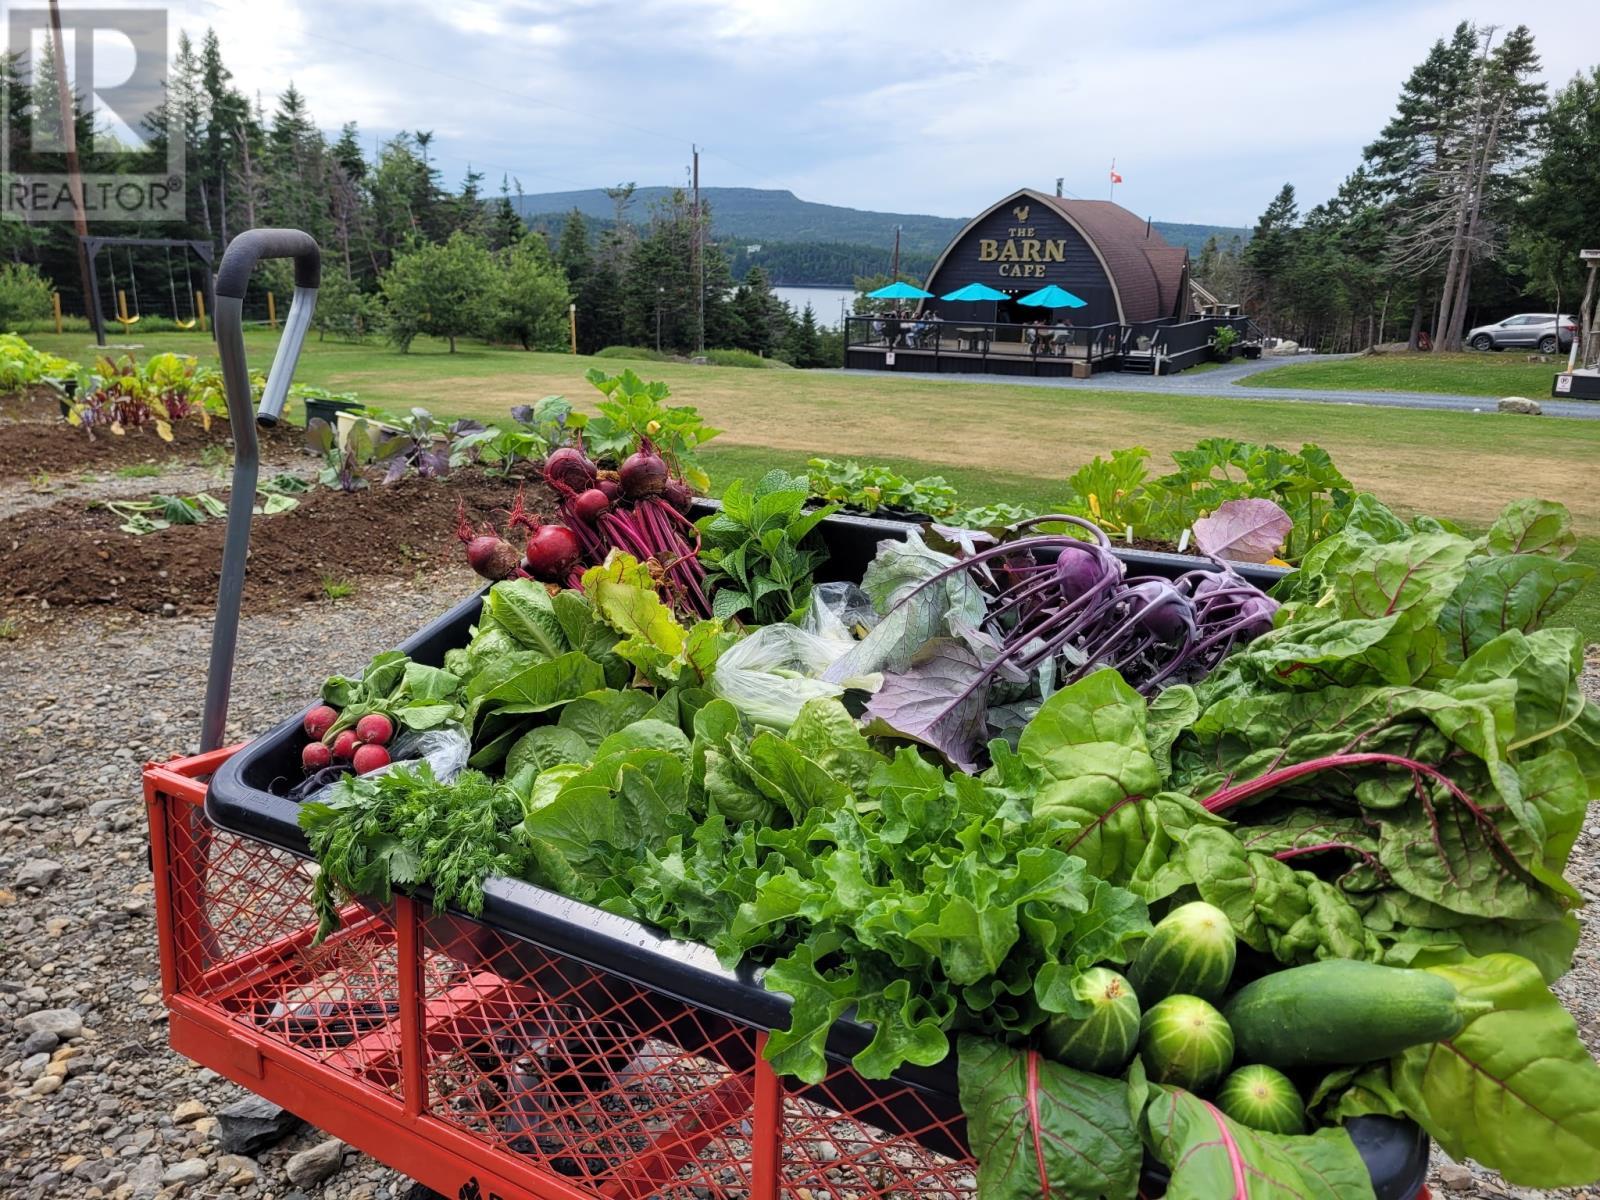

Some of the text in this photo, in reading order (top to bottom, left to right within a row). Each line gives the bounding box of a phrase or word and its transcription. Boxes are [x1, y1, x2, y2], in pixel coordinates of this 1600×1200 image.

[1008, 227, 1035, 237] THE
[978, 239, 1067, 262] BARN
[999, 264, 1046, 278] CAFE
